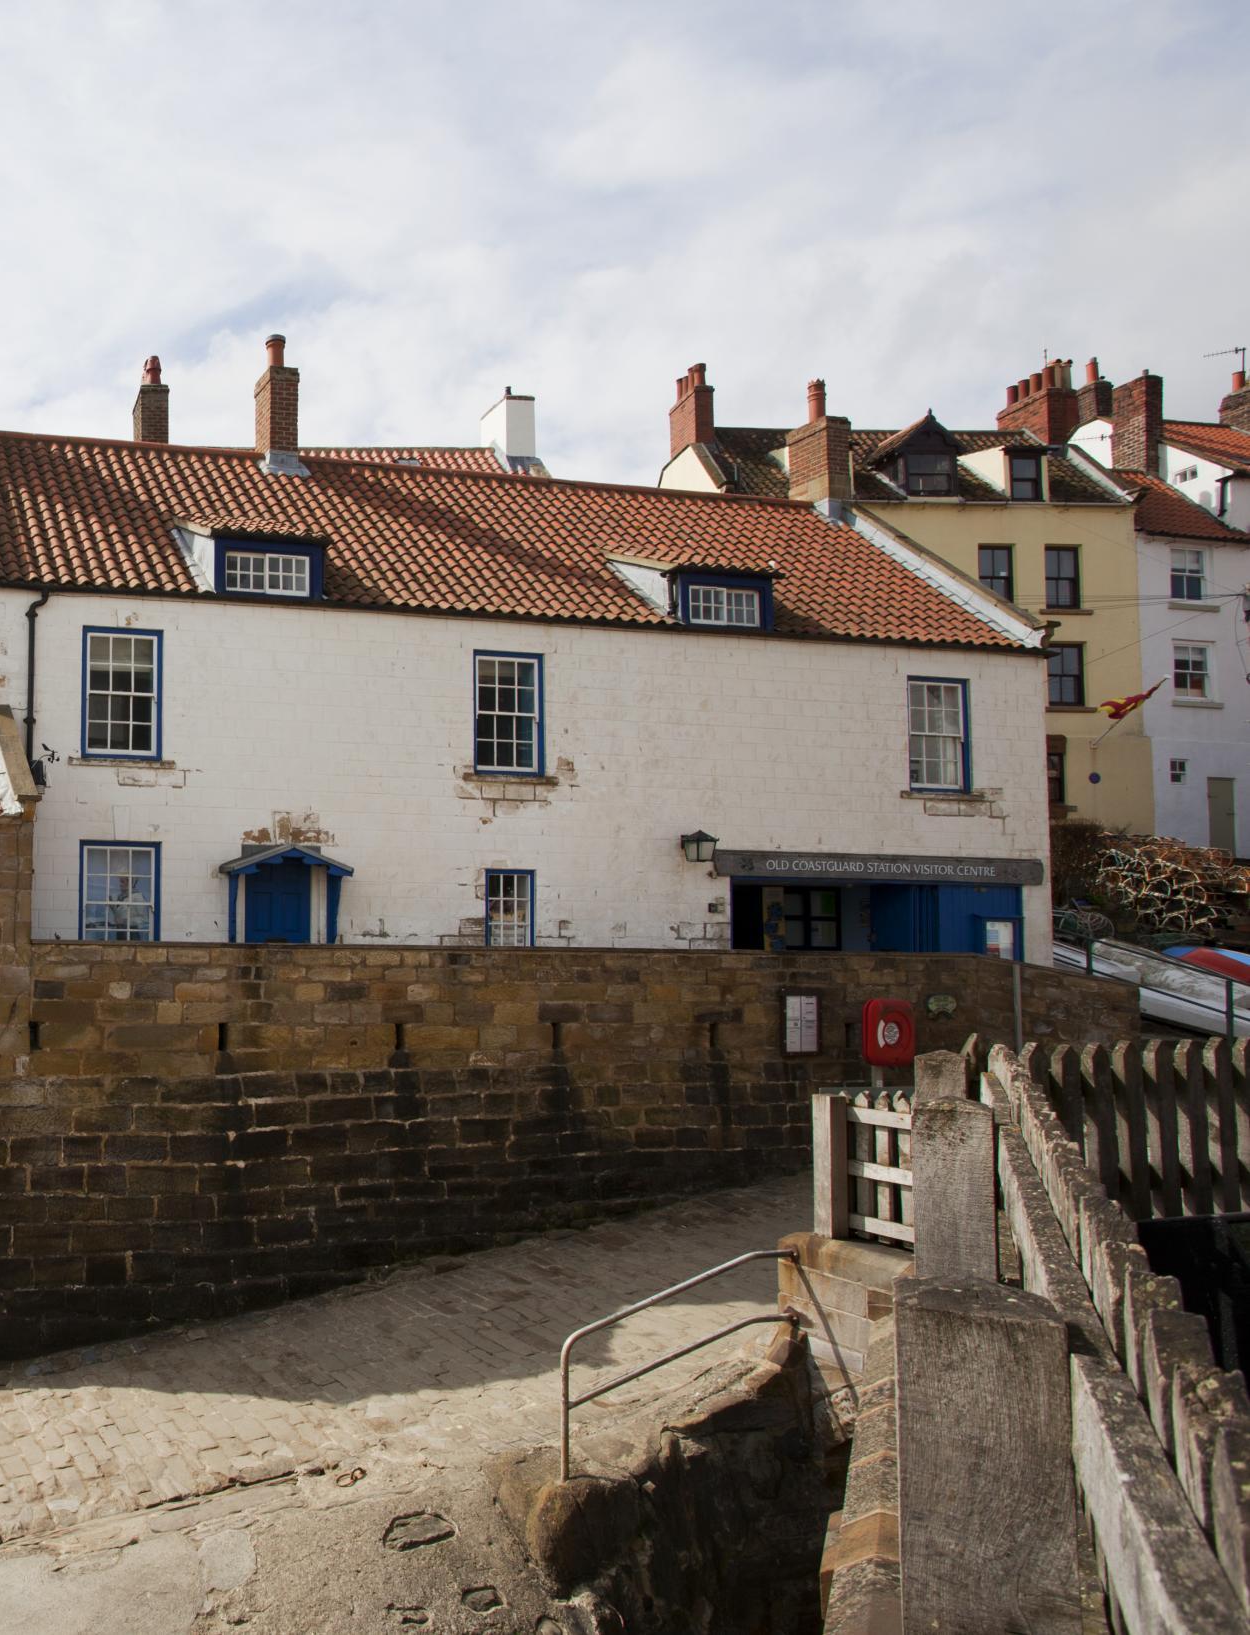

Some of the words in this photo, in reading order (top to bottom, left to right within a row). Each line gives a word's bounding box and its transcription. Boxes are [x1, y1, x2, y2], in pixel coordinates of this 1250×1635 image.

[766, 859, 789, 871] OLD
[792, 860, 865, 872] COASTGUARD
[867, 862, 911, 874] STATION
[913, 864, 955, 876] VISITOR
[957, 866, 997, 877] CENTRE
